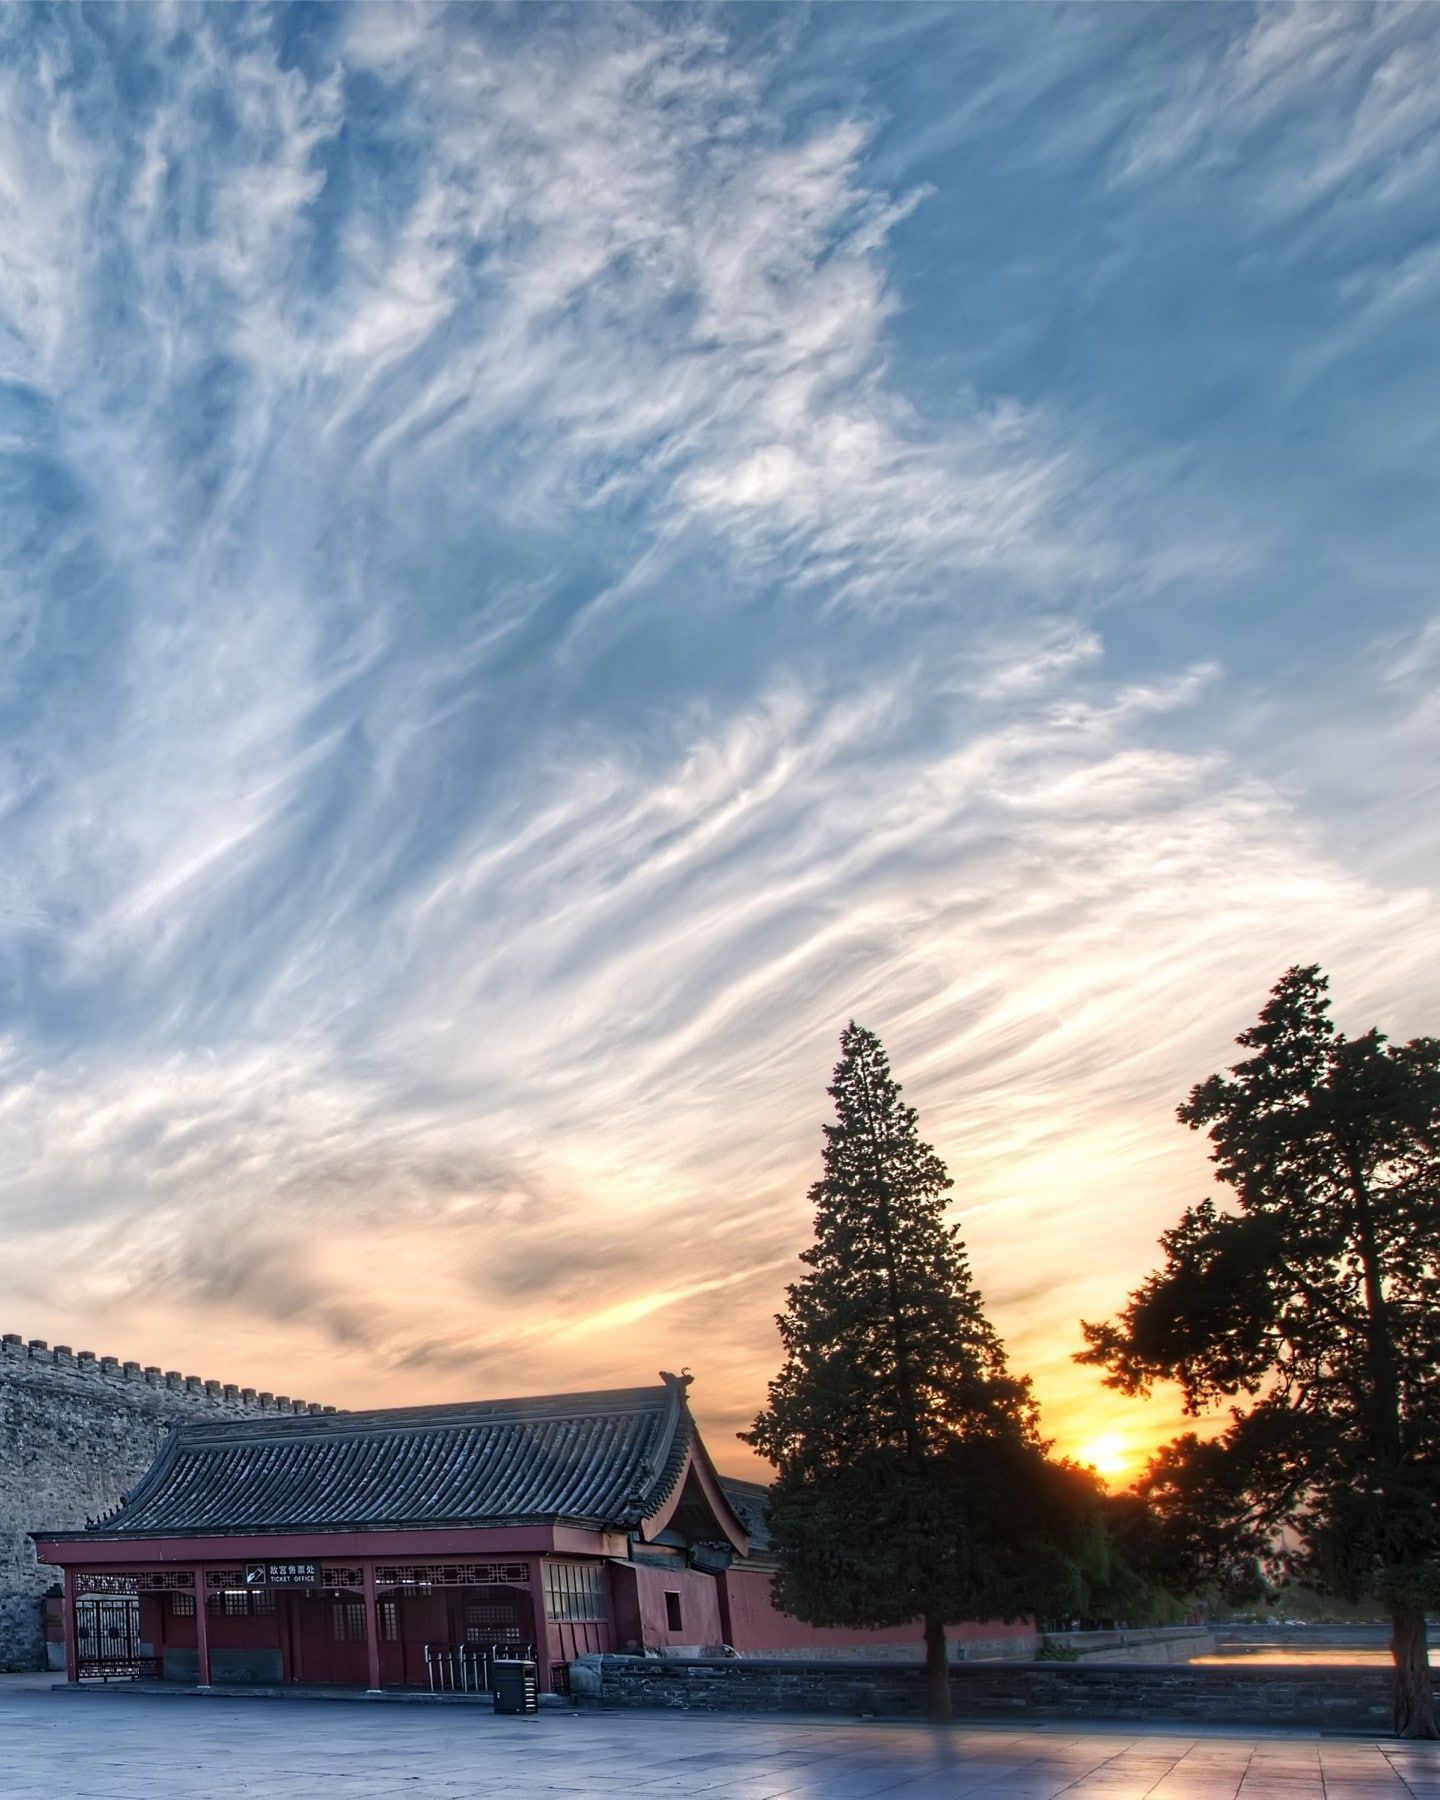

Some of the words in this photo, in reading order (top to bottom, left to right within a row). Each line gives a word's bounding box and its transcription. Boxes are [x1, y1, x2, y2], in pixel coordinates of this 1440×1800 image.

[270, 1565, 315, 1574] 故宫售票处
